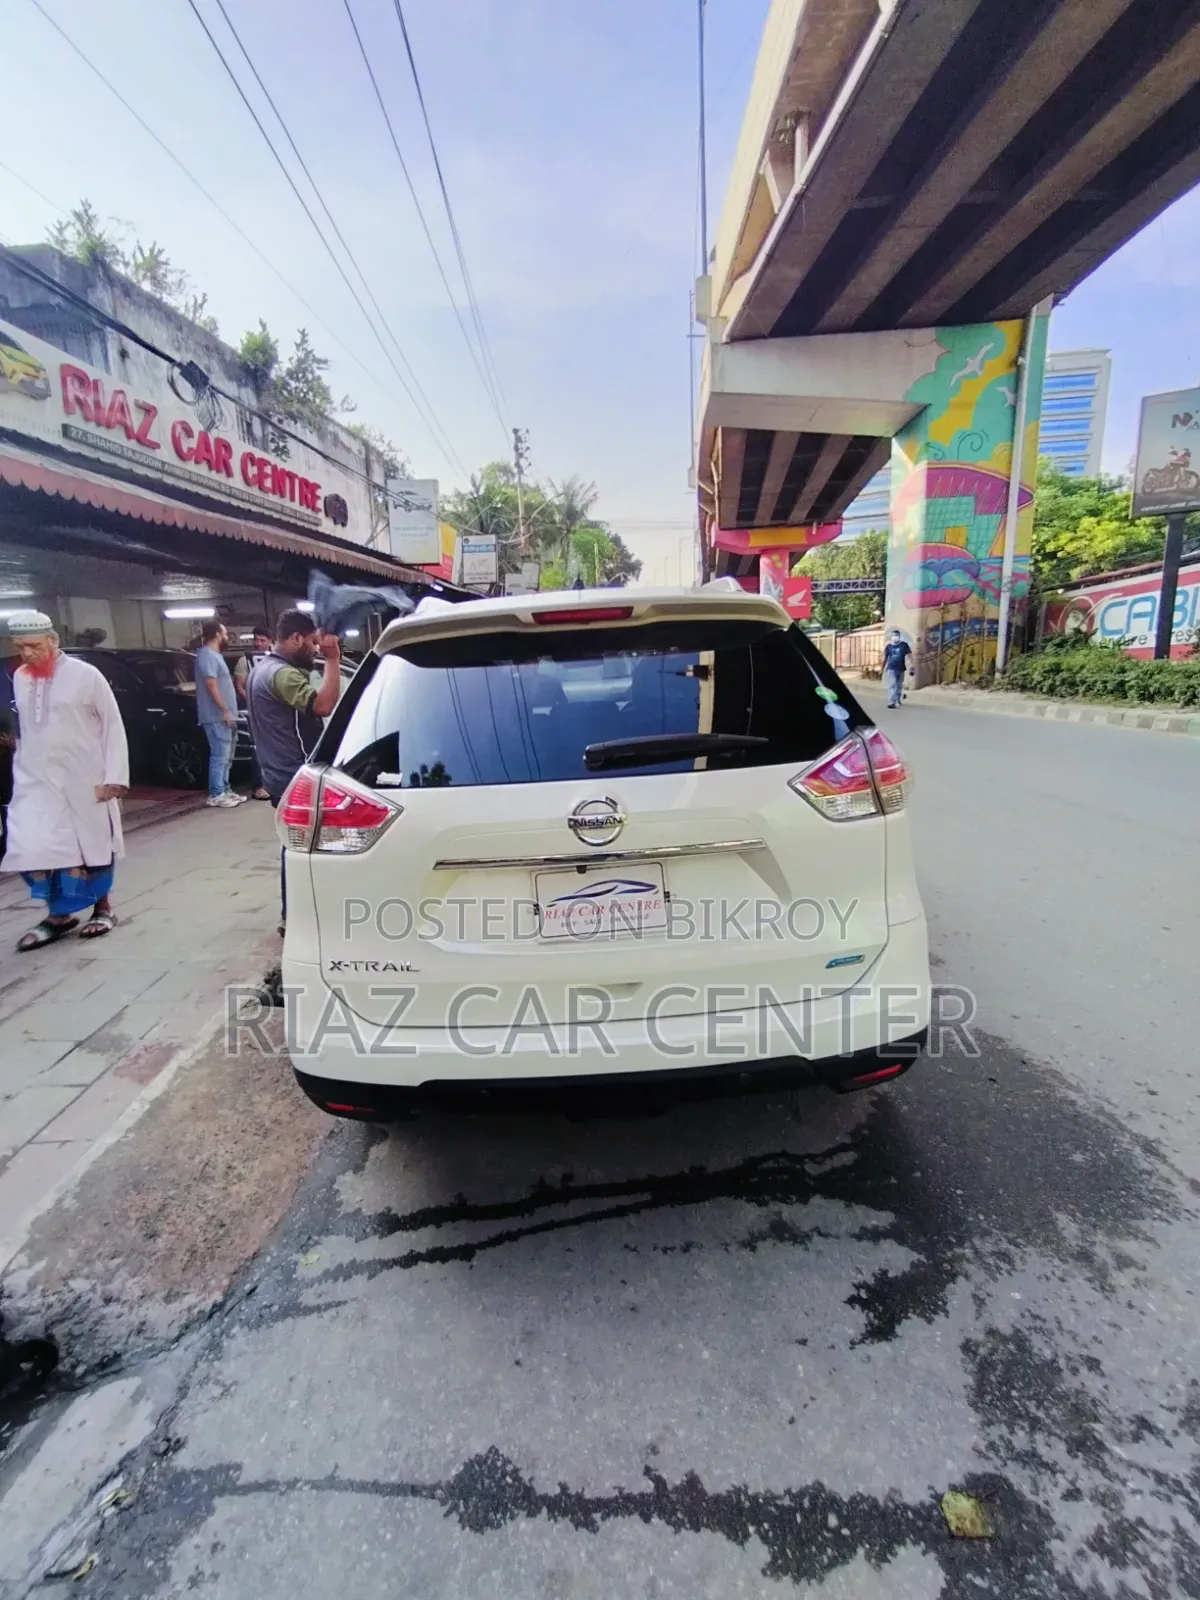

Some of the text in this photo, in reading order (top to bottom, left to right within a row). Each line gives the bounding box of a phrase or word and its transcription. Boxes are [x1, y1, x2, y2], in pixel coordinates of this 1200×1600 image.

[60, 363, 322, 513] RIAZ CAR CENTRE
[87, 432, 122, 454] SHAHID
[1100, 587, 1200, 637] CABI
[572, 815, 623, 828] NISSAN
[545, 899, 662, 920] RIAZ CAR CENTRE
[329, 960, 420, 972] X-TRAIL
